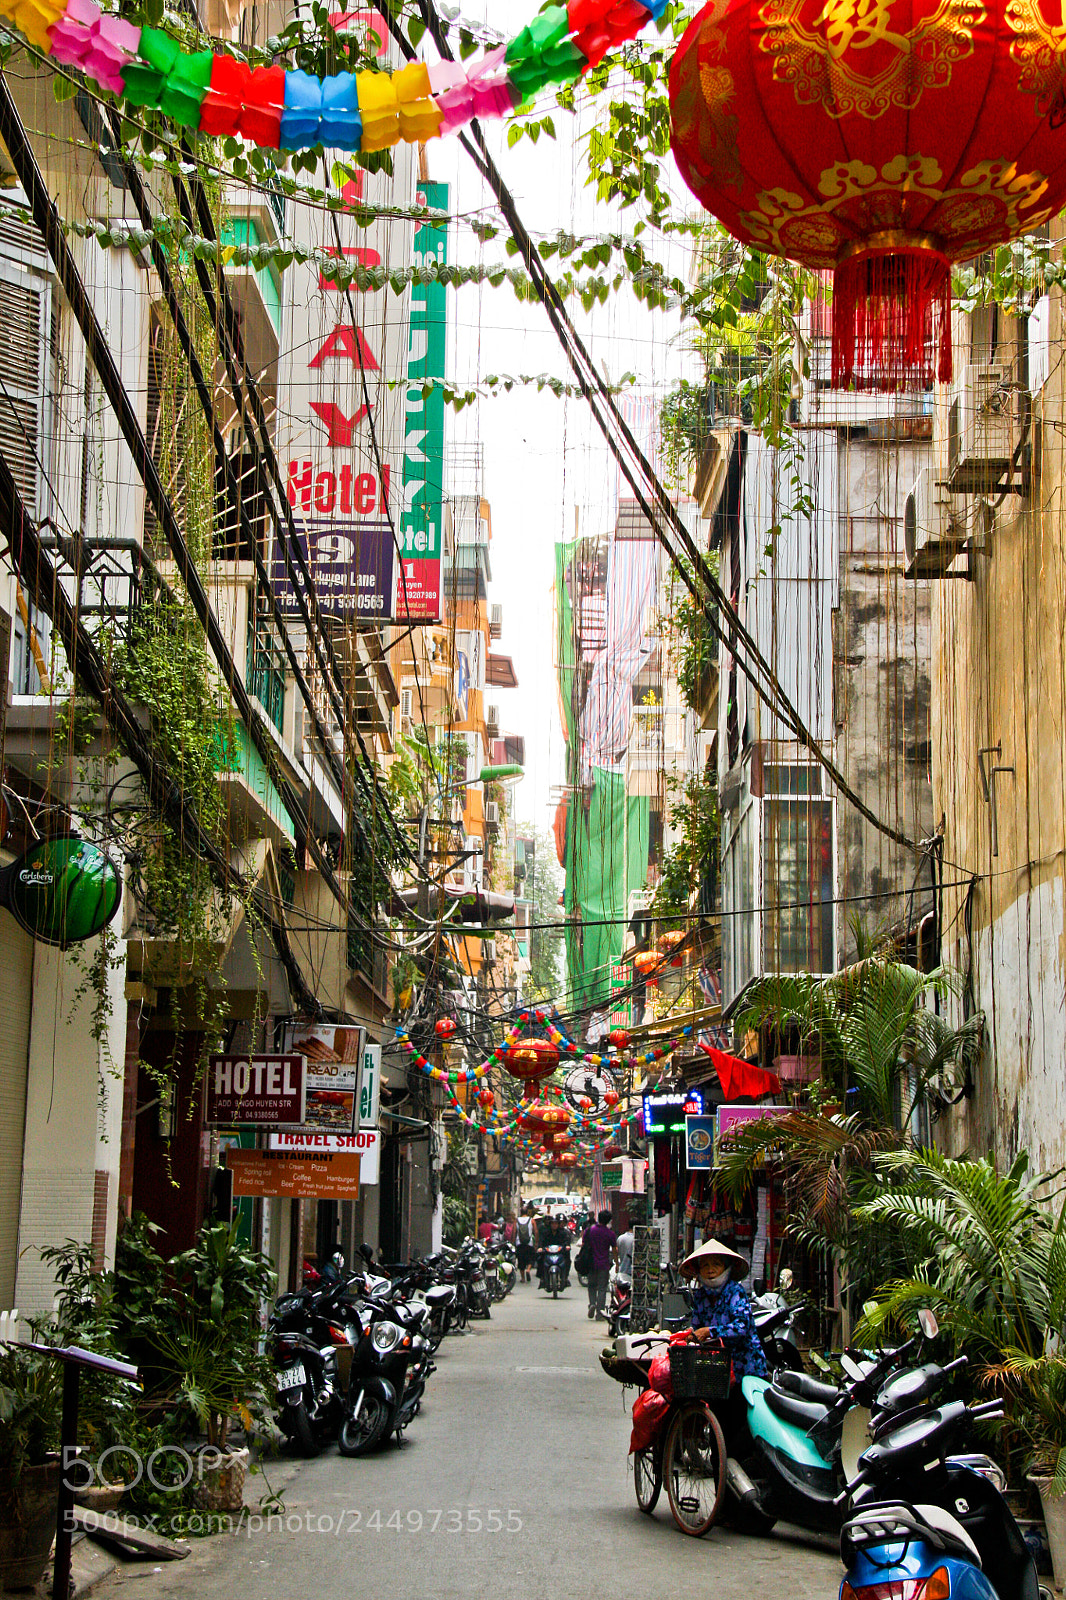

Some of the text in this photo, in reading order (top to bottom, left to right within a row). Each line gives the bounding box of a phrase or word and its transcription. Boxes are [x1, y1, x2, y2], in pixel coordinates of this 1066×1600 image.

[286, 461, 391, 515] Hotel
[316, 535, 354, 562] 9
[350, 571, 376, 587] Lane
[20, 869, 54, 884] Carlsberg
[215, 1061, 296, 1095] HOTEL
[256, 1100, 277, 1108] HUYEN
[279, 1100, 292, 1108] STR
[336, 1133, 376, 1148] SHOP
[262, 1151, 334, 1162] RESTAURANT
[244, 1168, 262, 1177] Spring
[311, 1164, 328, 1172] Pizza
[292, 1173, 312, 1182] Coffee
[326, 1175, 355, 1184] Hamburger
[281, 1180, 294, 1188] Beer
